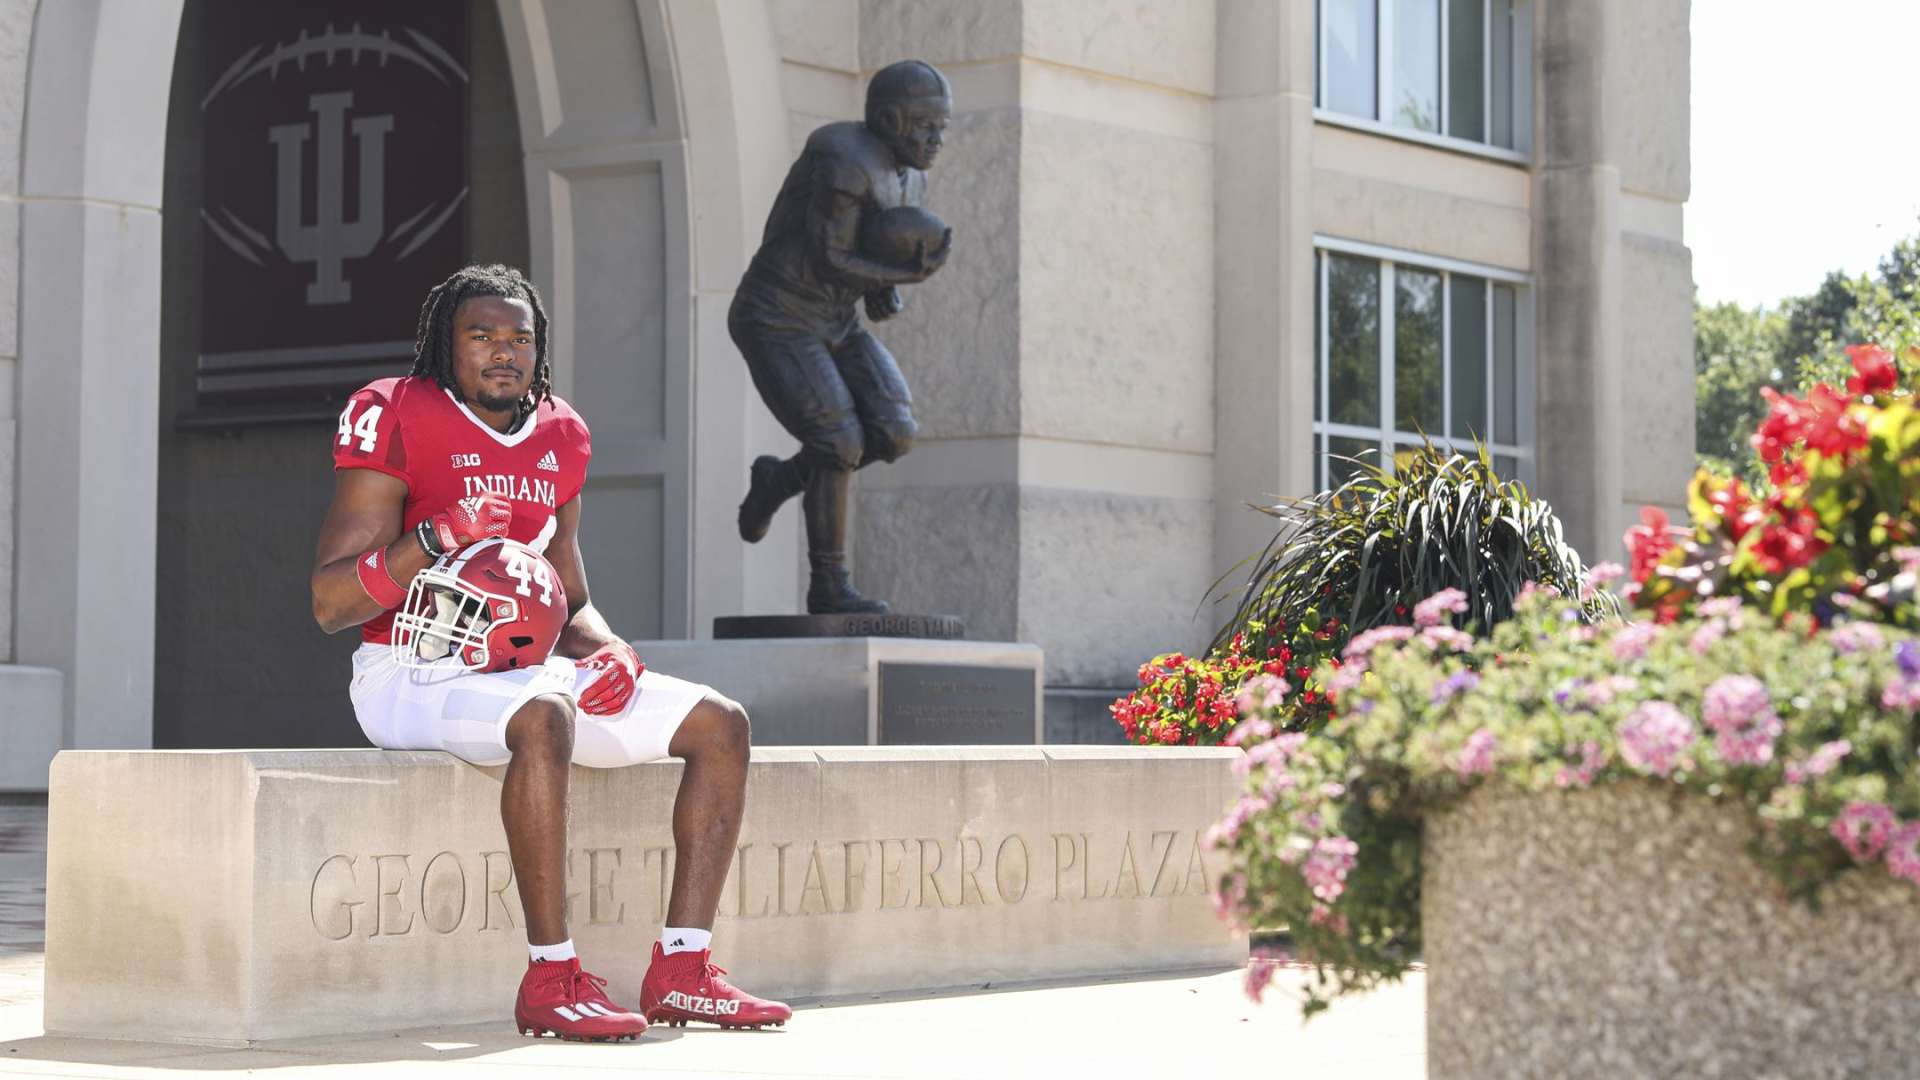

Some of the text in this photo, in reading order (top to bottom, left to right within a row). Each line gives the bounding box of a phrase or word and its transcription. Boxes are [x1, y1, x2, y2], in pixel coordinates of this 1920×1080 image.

[338, 400, 383, 453] 44
[537, 462, 559, 472] adidas
[463, 475, 555, 508] INDIANA
[458, 499, 477, 523] adidas
[505, 552, 553, 608] 44
[845, 616, 918, 636] GEORGE
[311, 829, 1211, 941] GEORE TLIAFERRO PLAZA
[662, 990, 740, 1015] ADIZERO
